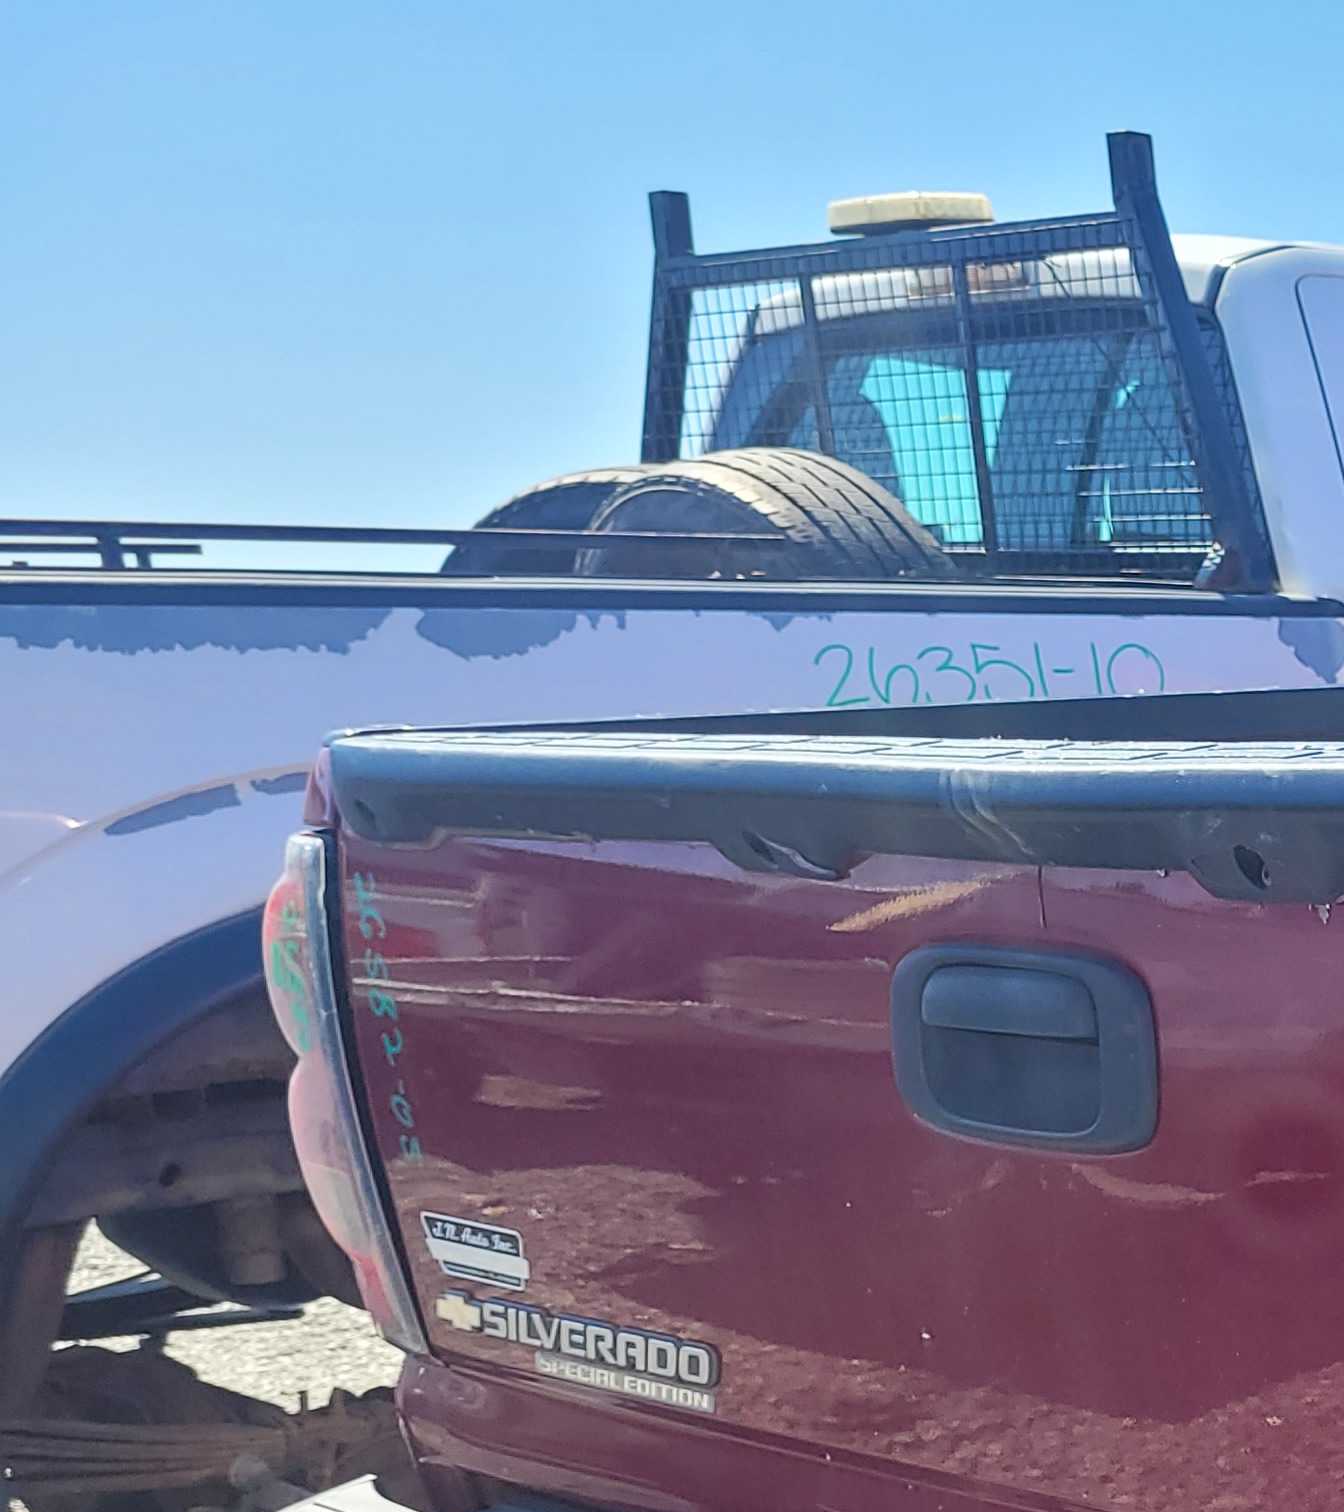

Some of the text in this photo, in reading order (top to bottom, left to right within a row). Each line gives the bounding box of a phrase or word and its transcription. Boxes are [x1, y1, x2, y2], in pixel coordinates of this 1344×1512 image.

[814, 642, 1165, 706] 26351-10
[461, 1227, 490, 1247] Auto
[481, 1299, 720, 1387] SILVERADO
[537, 1357, 709, 1409] SPECIAL EDITION
